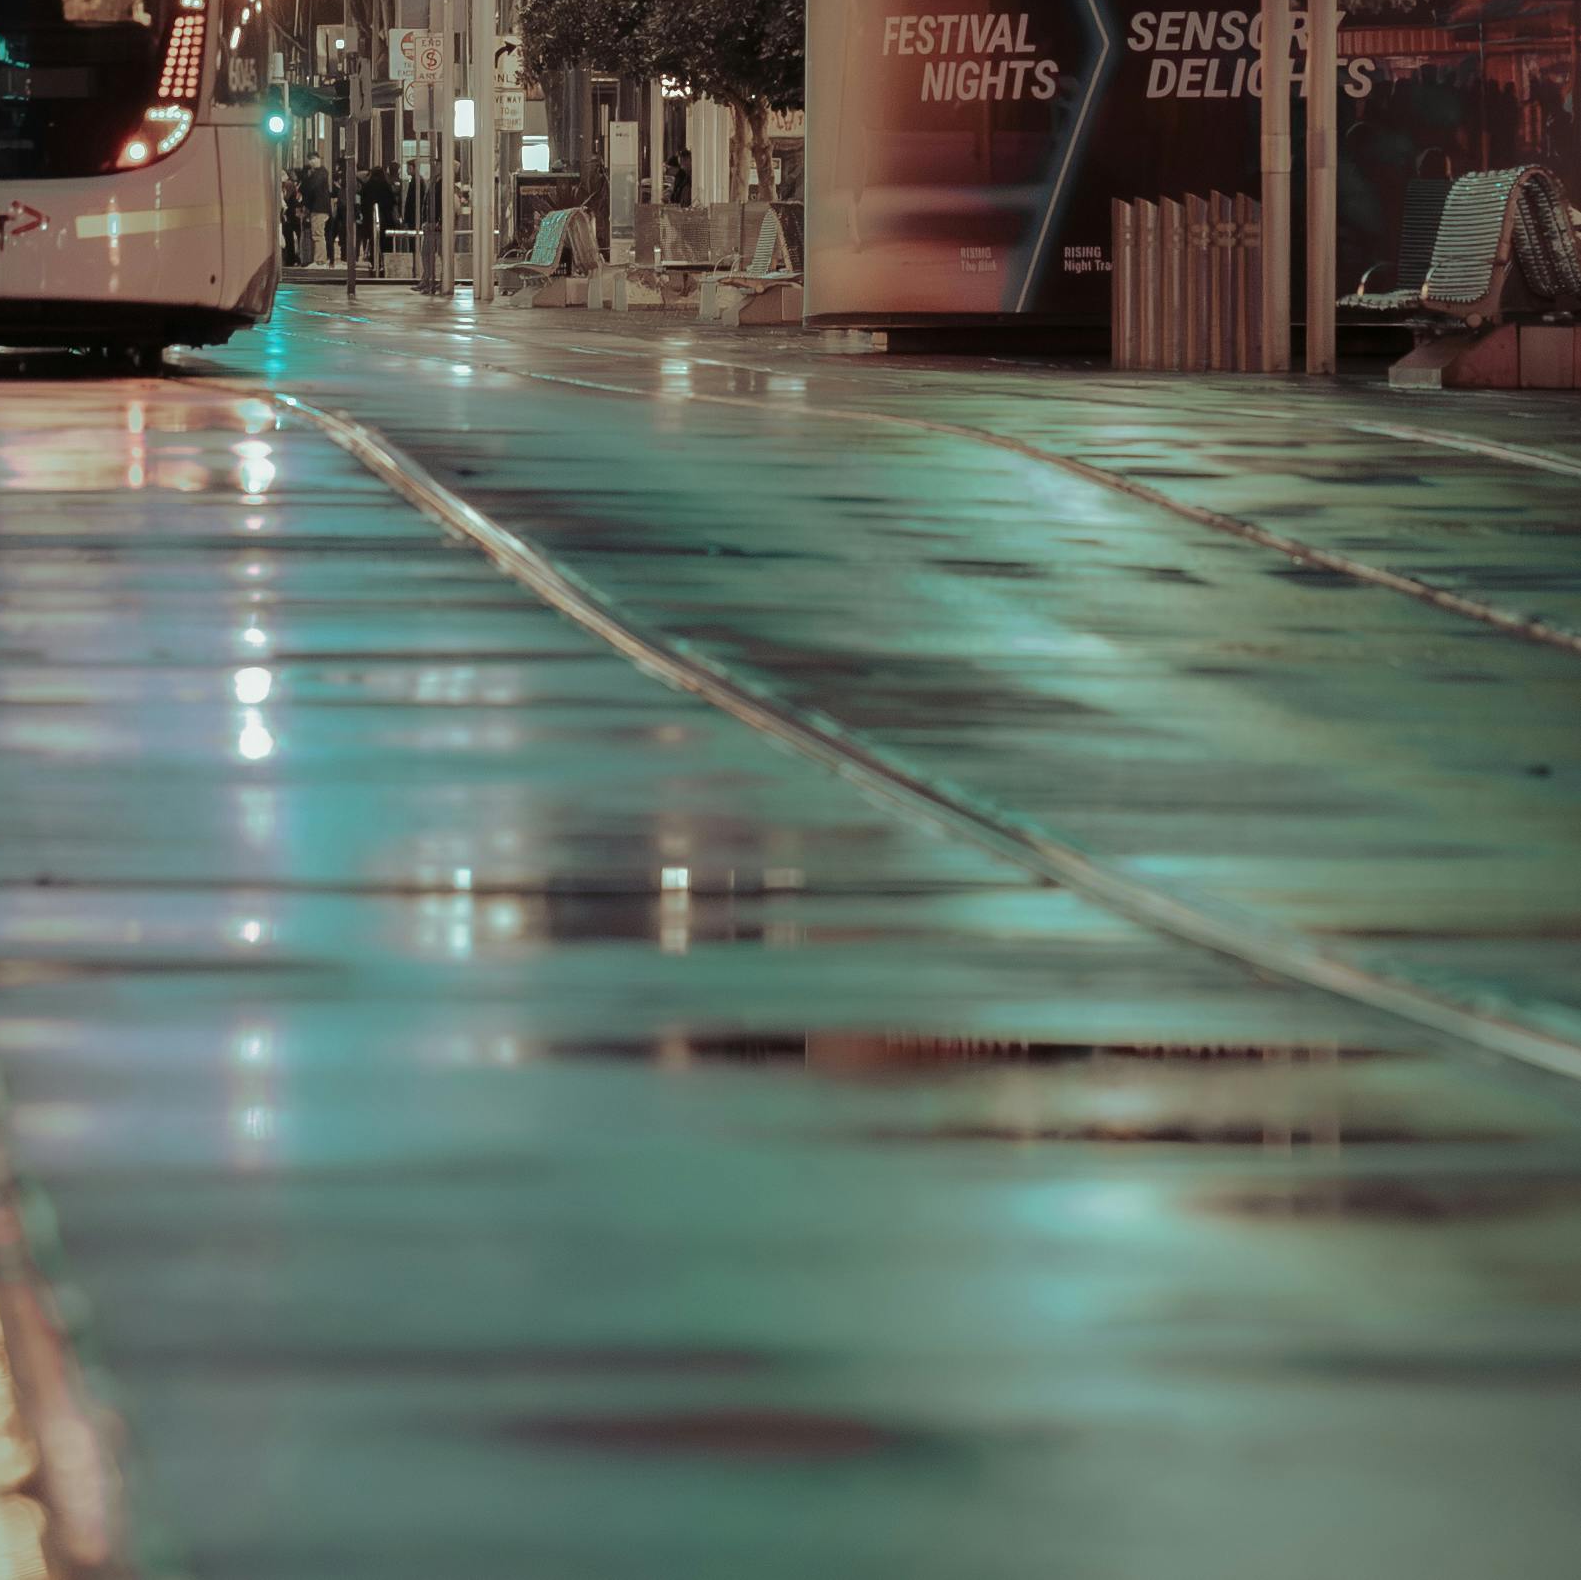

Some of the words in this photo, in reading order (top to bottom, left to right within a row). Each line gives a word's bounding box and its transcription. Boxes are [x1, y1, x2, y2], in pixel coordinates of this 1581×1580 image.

[883, 13, 1036, 56] FESTIVAL
[921, 59, 1059, 102] NIGHTS
[1064, 246, 1102, 259] RISING
[1064, 259, 1092, 274] Night
